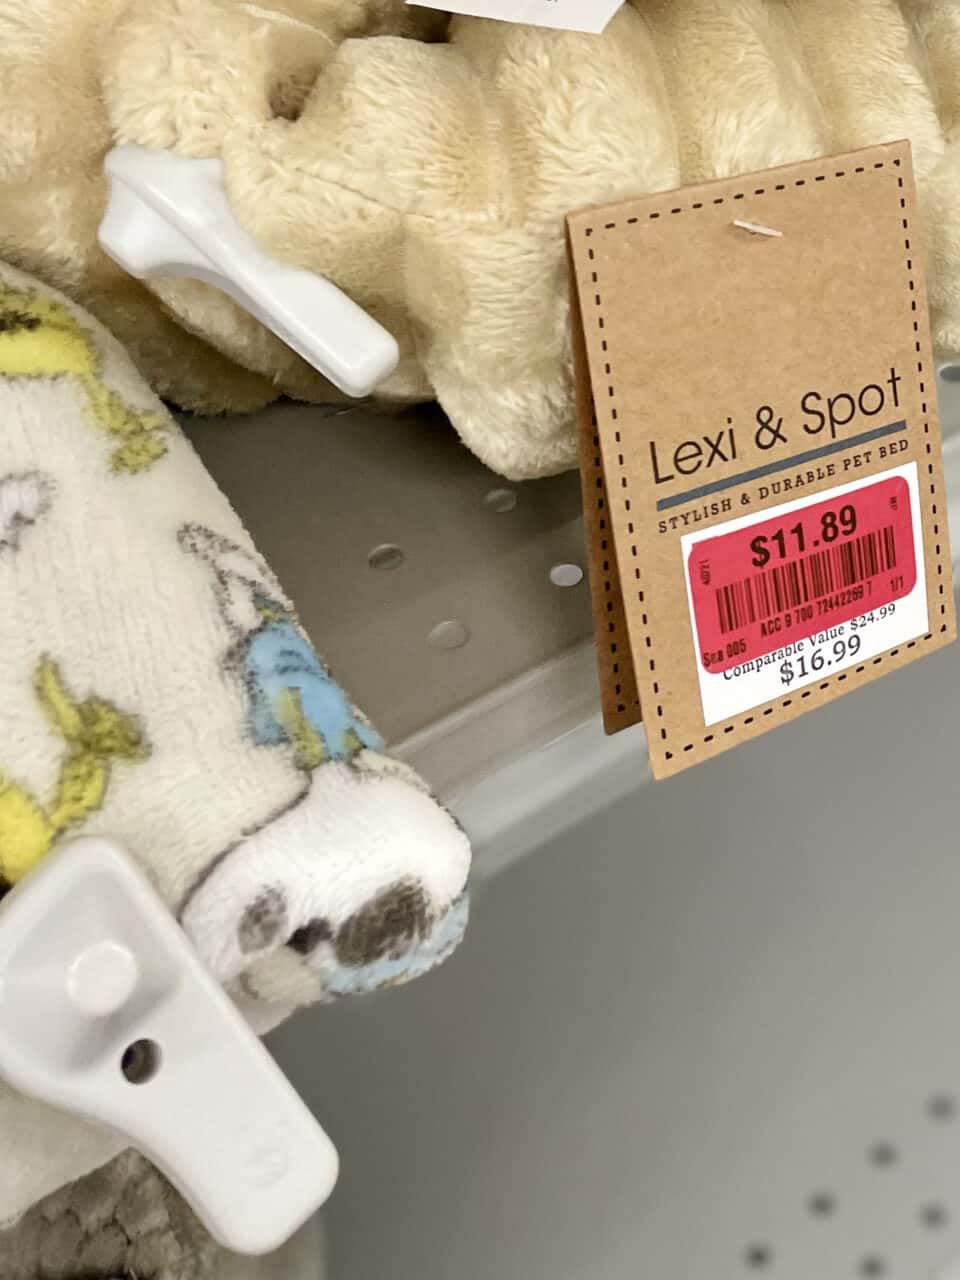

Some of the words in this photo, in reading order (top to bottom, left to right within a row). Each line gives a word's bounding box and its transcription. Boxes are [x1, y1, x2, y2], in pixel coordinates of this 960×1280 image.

[649, 417, 737, 485] Lexi
[754, 405, 788, 450] &
[800, 367, 901, 439] Spot
[658, 496, 732, 534] STYLISH
[740, 493, 752, 506] &
[759, 463, 837, 500] DURABLE
[843, 449, 873, 472] PET
[879, 438, 909, 460] BED
[750, 504, 858, 569] $11.89
[723, 640, 805, 681] Comparable
[807, 626, 846, 649] Value
[850, 603, 897, 631] $24.99
[760, 617, 782, 638] ACC
[780, 634, 862, 686] $16.99
